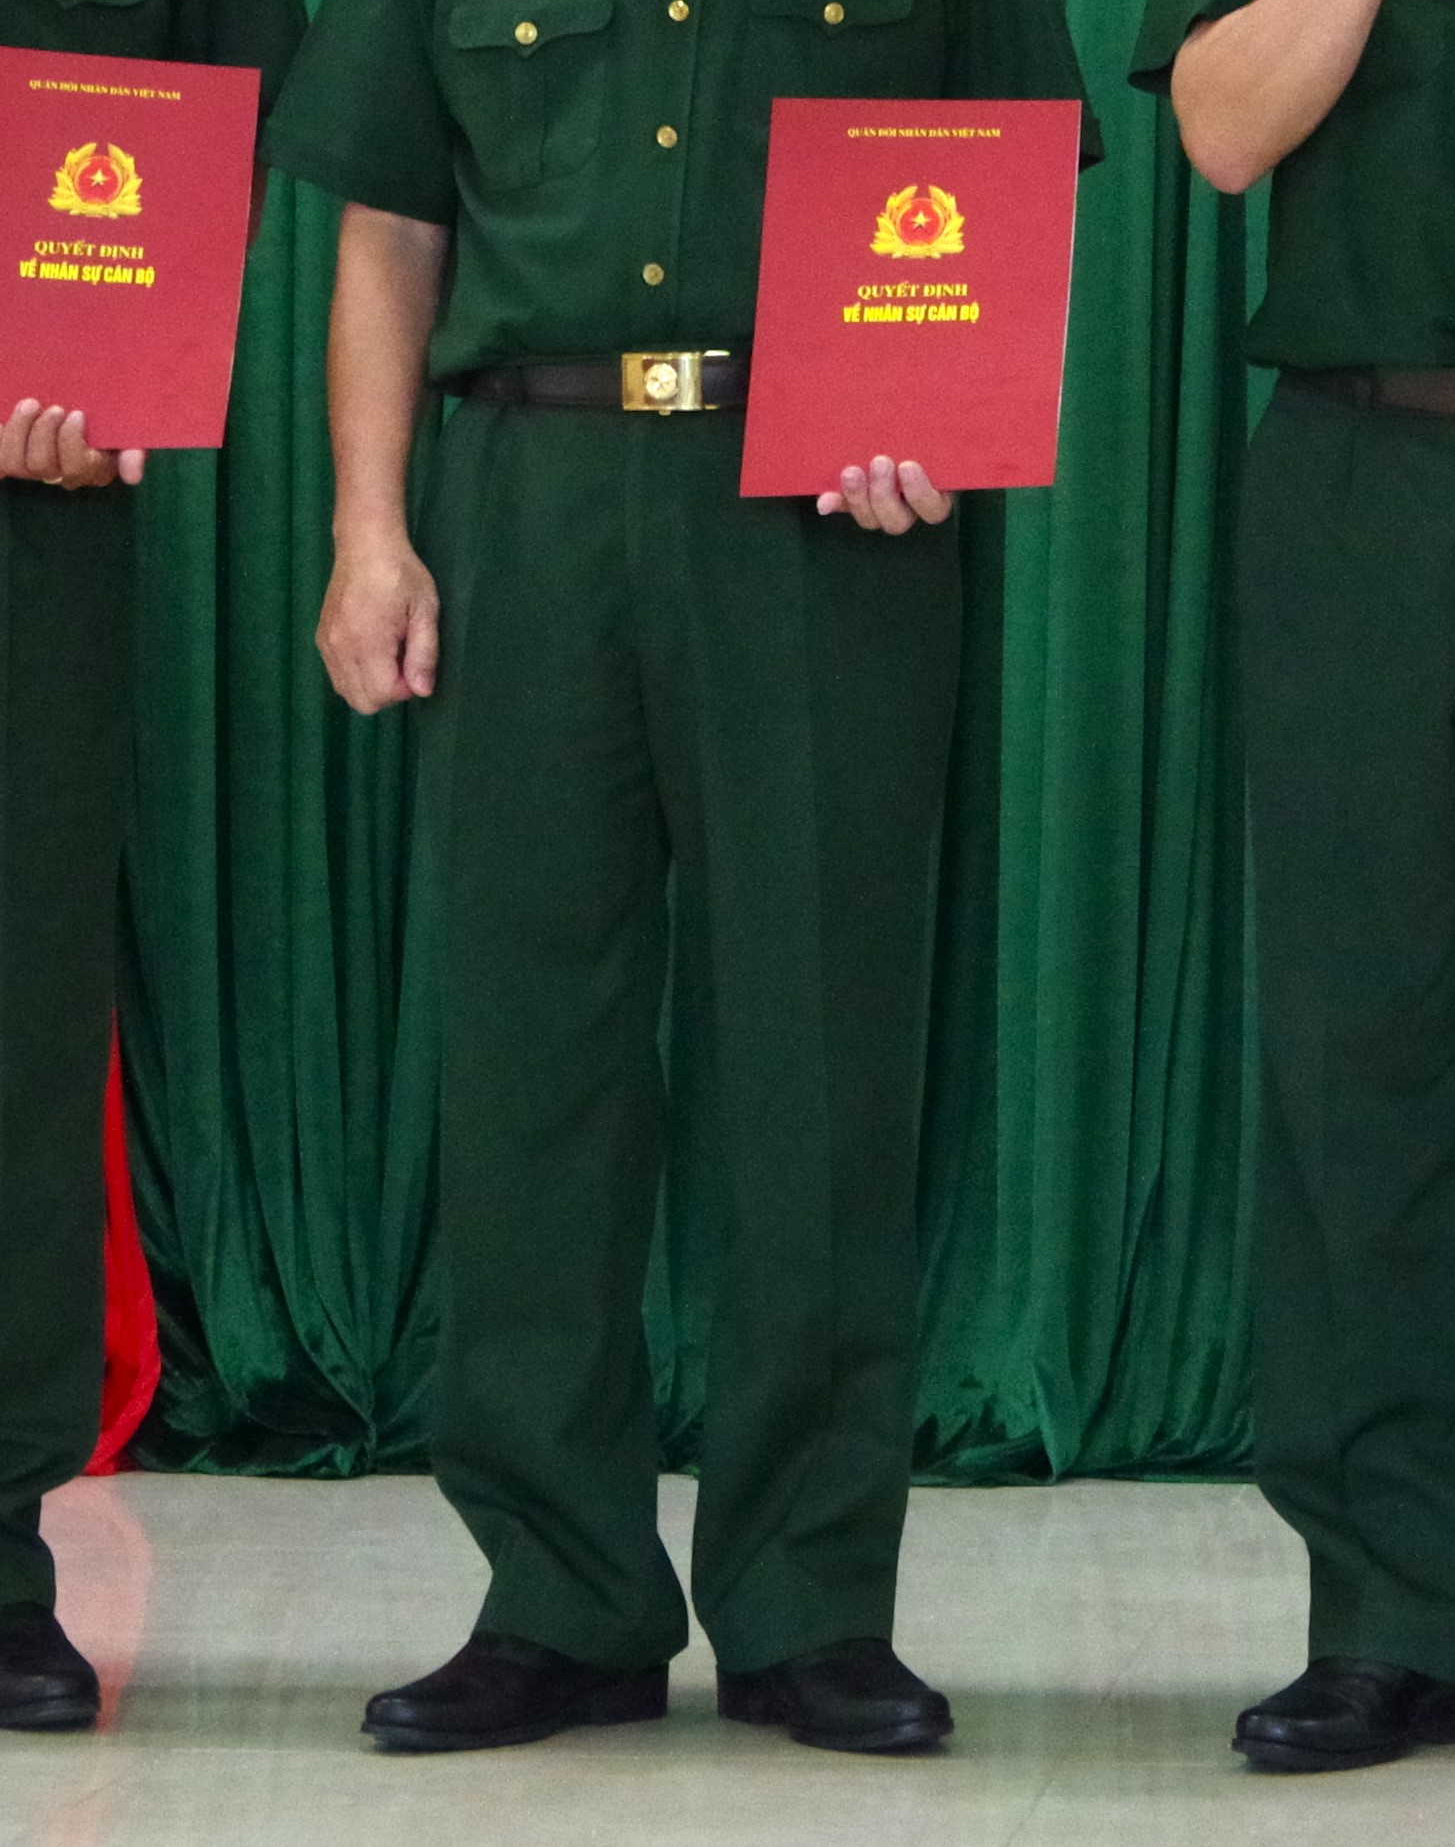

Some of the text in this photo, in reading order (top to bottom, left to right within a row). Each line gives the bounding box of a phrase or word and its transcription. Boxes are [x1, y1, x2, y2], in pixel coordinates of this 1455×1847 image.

[34, 239, 144, 260] QUYẾT ĐỊNH
[39, 260, 79, 281] NHÂN
[103, 264, 133, 284] CÁN
[135, 266, 155, 288] BỘ
[857, 280, 968, 300] QUYẾT ĐỊNH
[863, 303, 903, 323] NHÂN
[928, 302, 957, 322] CÁN
[960, 301, 980, 324] BỘ
